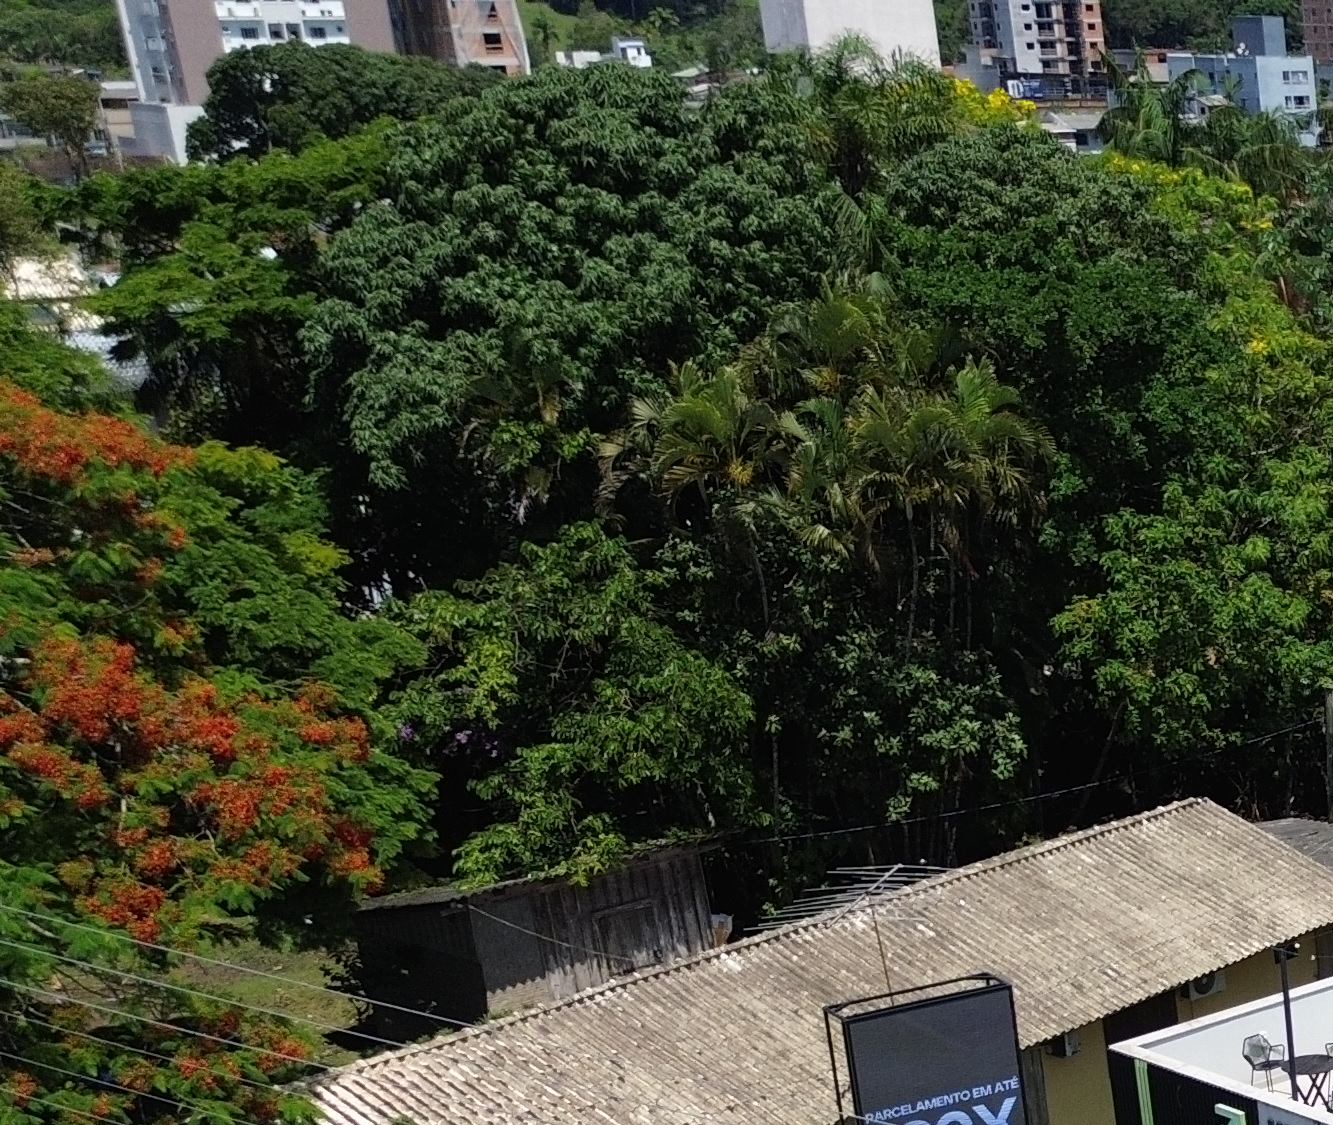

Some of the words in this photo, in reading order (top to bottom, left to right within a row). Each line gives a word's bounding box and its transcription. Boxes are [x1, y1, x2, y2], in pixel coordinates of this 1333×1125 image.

[865, 1090, 971, 1125] PARCELAMENTO
[972, 1085, 992, 1099] EM
[994, 1076, 1020, 1093] ATÉ
